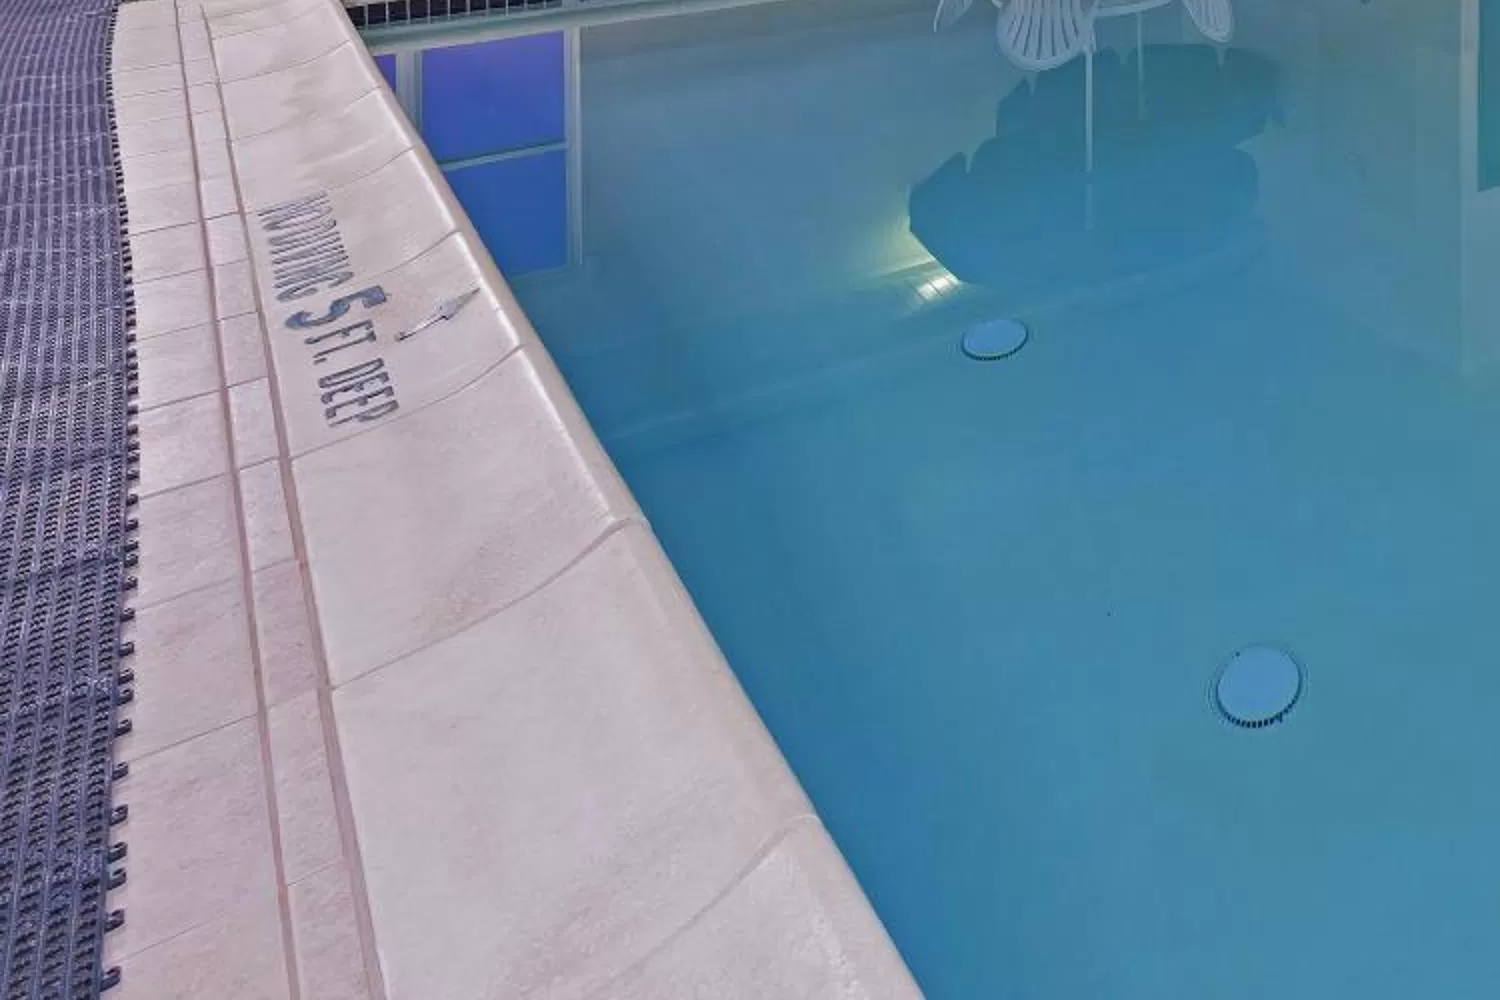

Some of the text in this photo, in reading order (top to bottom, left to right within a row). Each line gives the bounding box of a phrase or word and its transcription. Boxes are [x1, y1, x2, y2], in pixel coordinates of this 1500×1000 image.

[255, 190, 334, 233] NO
[267, 217, 355, 303] DIVING
[283, 284, 390, 330] 5
[318, 357, 400, 428] DEEP
